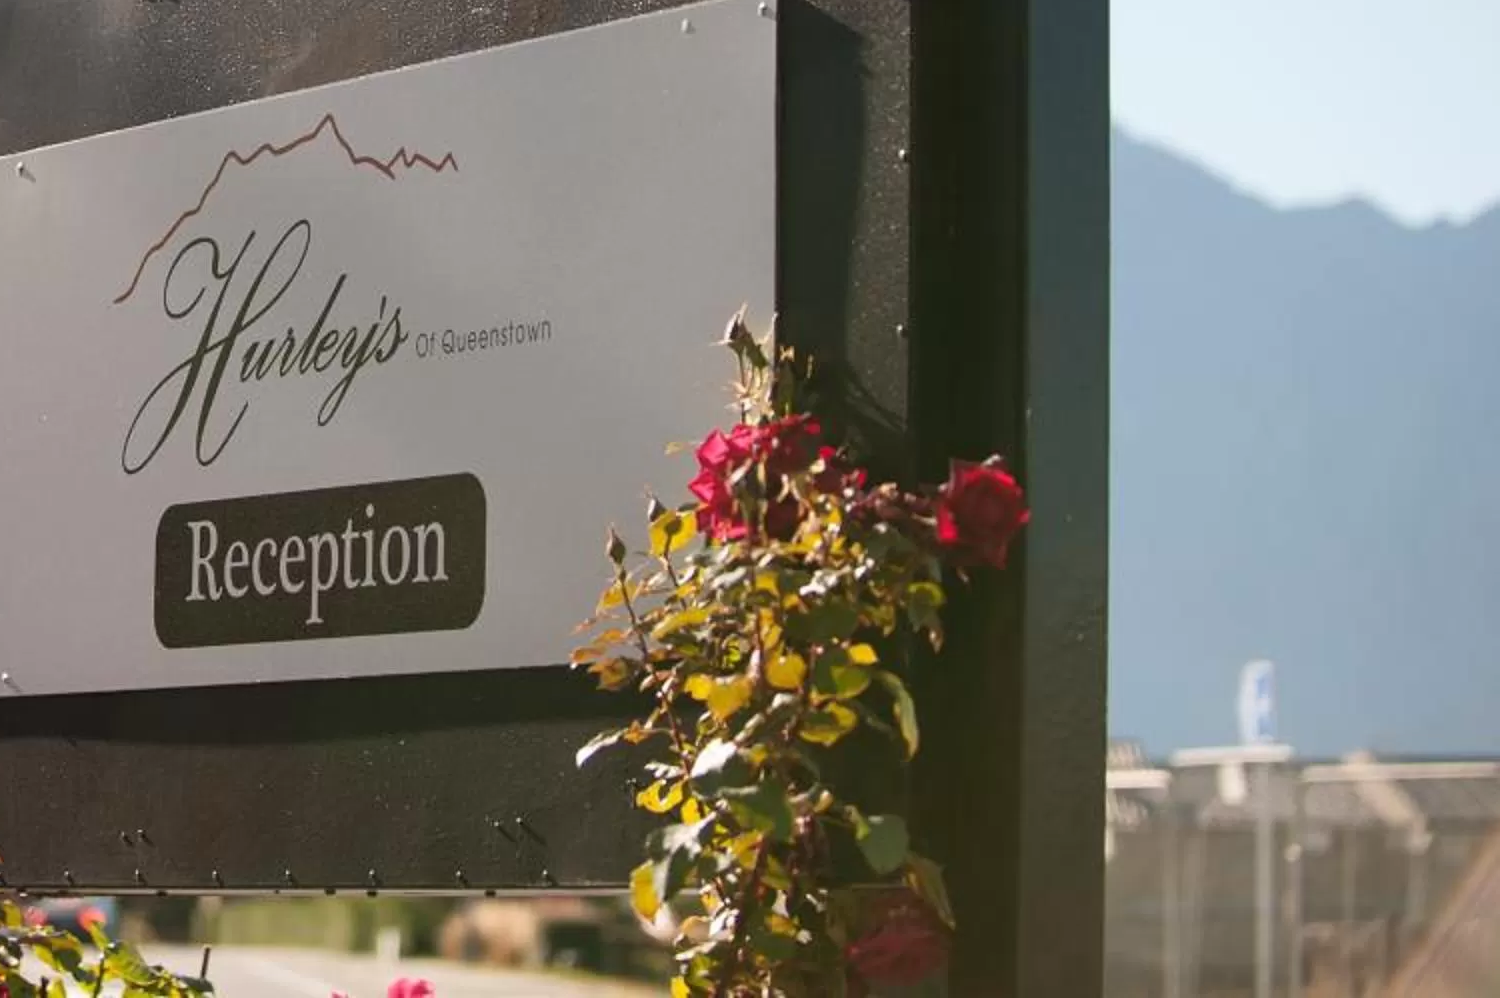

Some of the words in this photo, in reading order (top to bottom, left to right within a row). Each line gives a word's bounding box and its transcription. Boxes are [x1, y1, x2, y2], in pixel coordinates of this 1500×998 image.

[122, 219, 408, 474] Hurley's
[415, 332, 437, 358] Of
[441, 318, 552, 356] Queenstown
[185, 504, 449, 626] Reception
